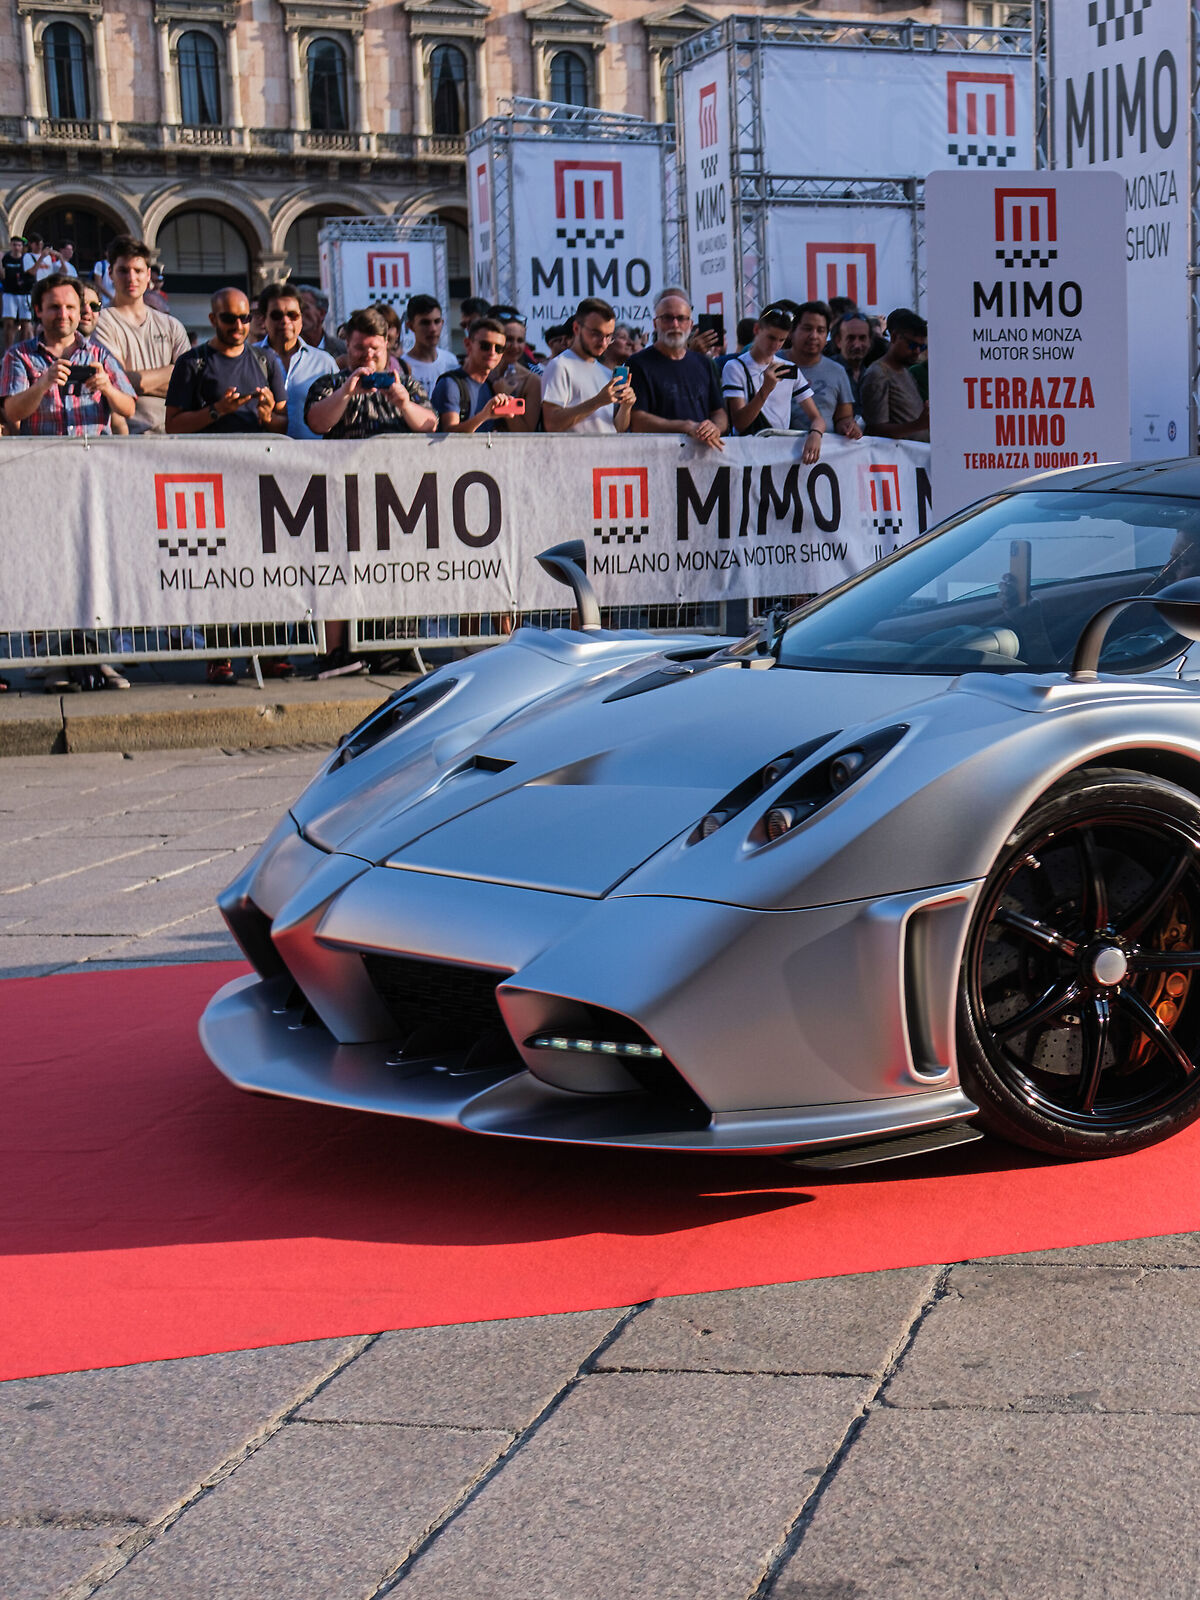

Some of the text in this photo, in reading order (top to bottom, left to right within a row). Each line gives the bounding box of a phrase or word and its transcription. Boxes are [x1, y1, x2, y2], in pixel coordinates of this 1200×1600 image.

[1066, 50, 1177, 169] MIMO
[695, 183, 726, 232] MIMO
[1125, 169, 1178, 212] MONZA
[1126, 222, 1171, 262] SHOW
[531, 256, 651, 297] MIMO
[532, 304, 652, 321] MILAN ONZA
[973, 281, 1083, 318] MIMO
[973, 328, 1083, 342] MILANO MONZA
[980, 346, 1075, 361] MOTOR SHOW
[963, 377, 1096, 409] TERRAZZA
[995, 414, 1066, 447] MIMO
[963, 451, 1099, 470] TERRAZZA DUOMO 21
[258, 470, 502, 554] MIMO
[676, 462, 842, 541] MIMO
[160, 558, 502, 590] MILANO MONZA MOTOR SHOW
[593, 553, 670, 576] MILANO
[676, 549, 741, 572] MONZA
[743, 544, 797, 567] MOTOR
[800, 541, 848, 563] SHOW
